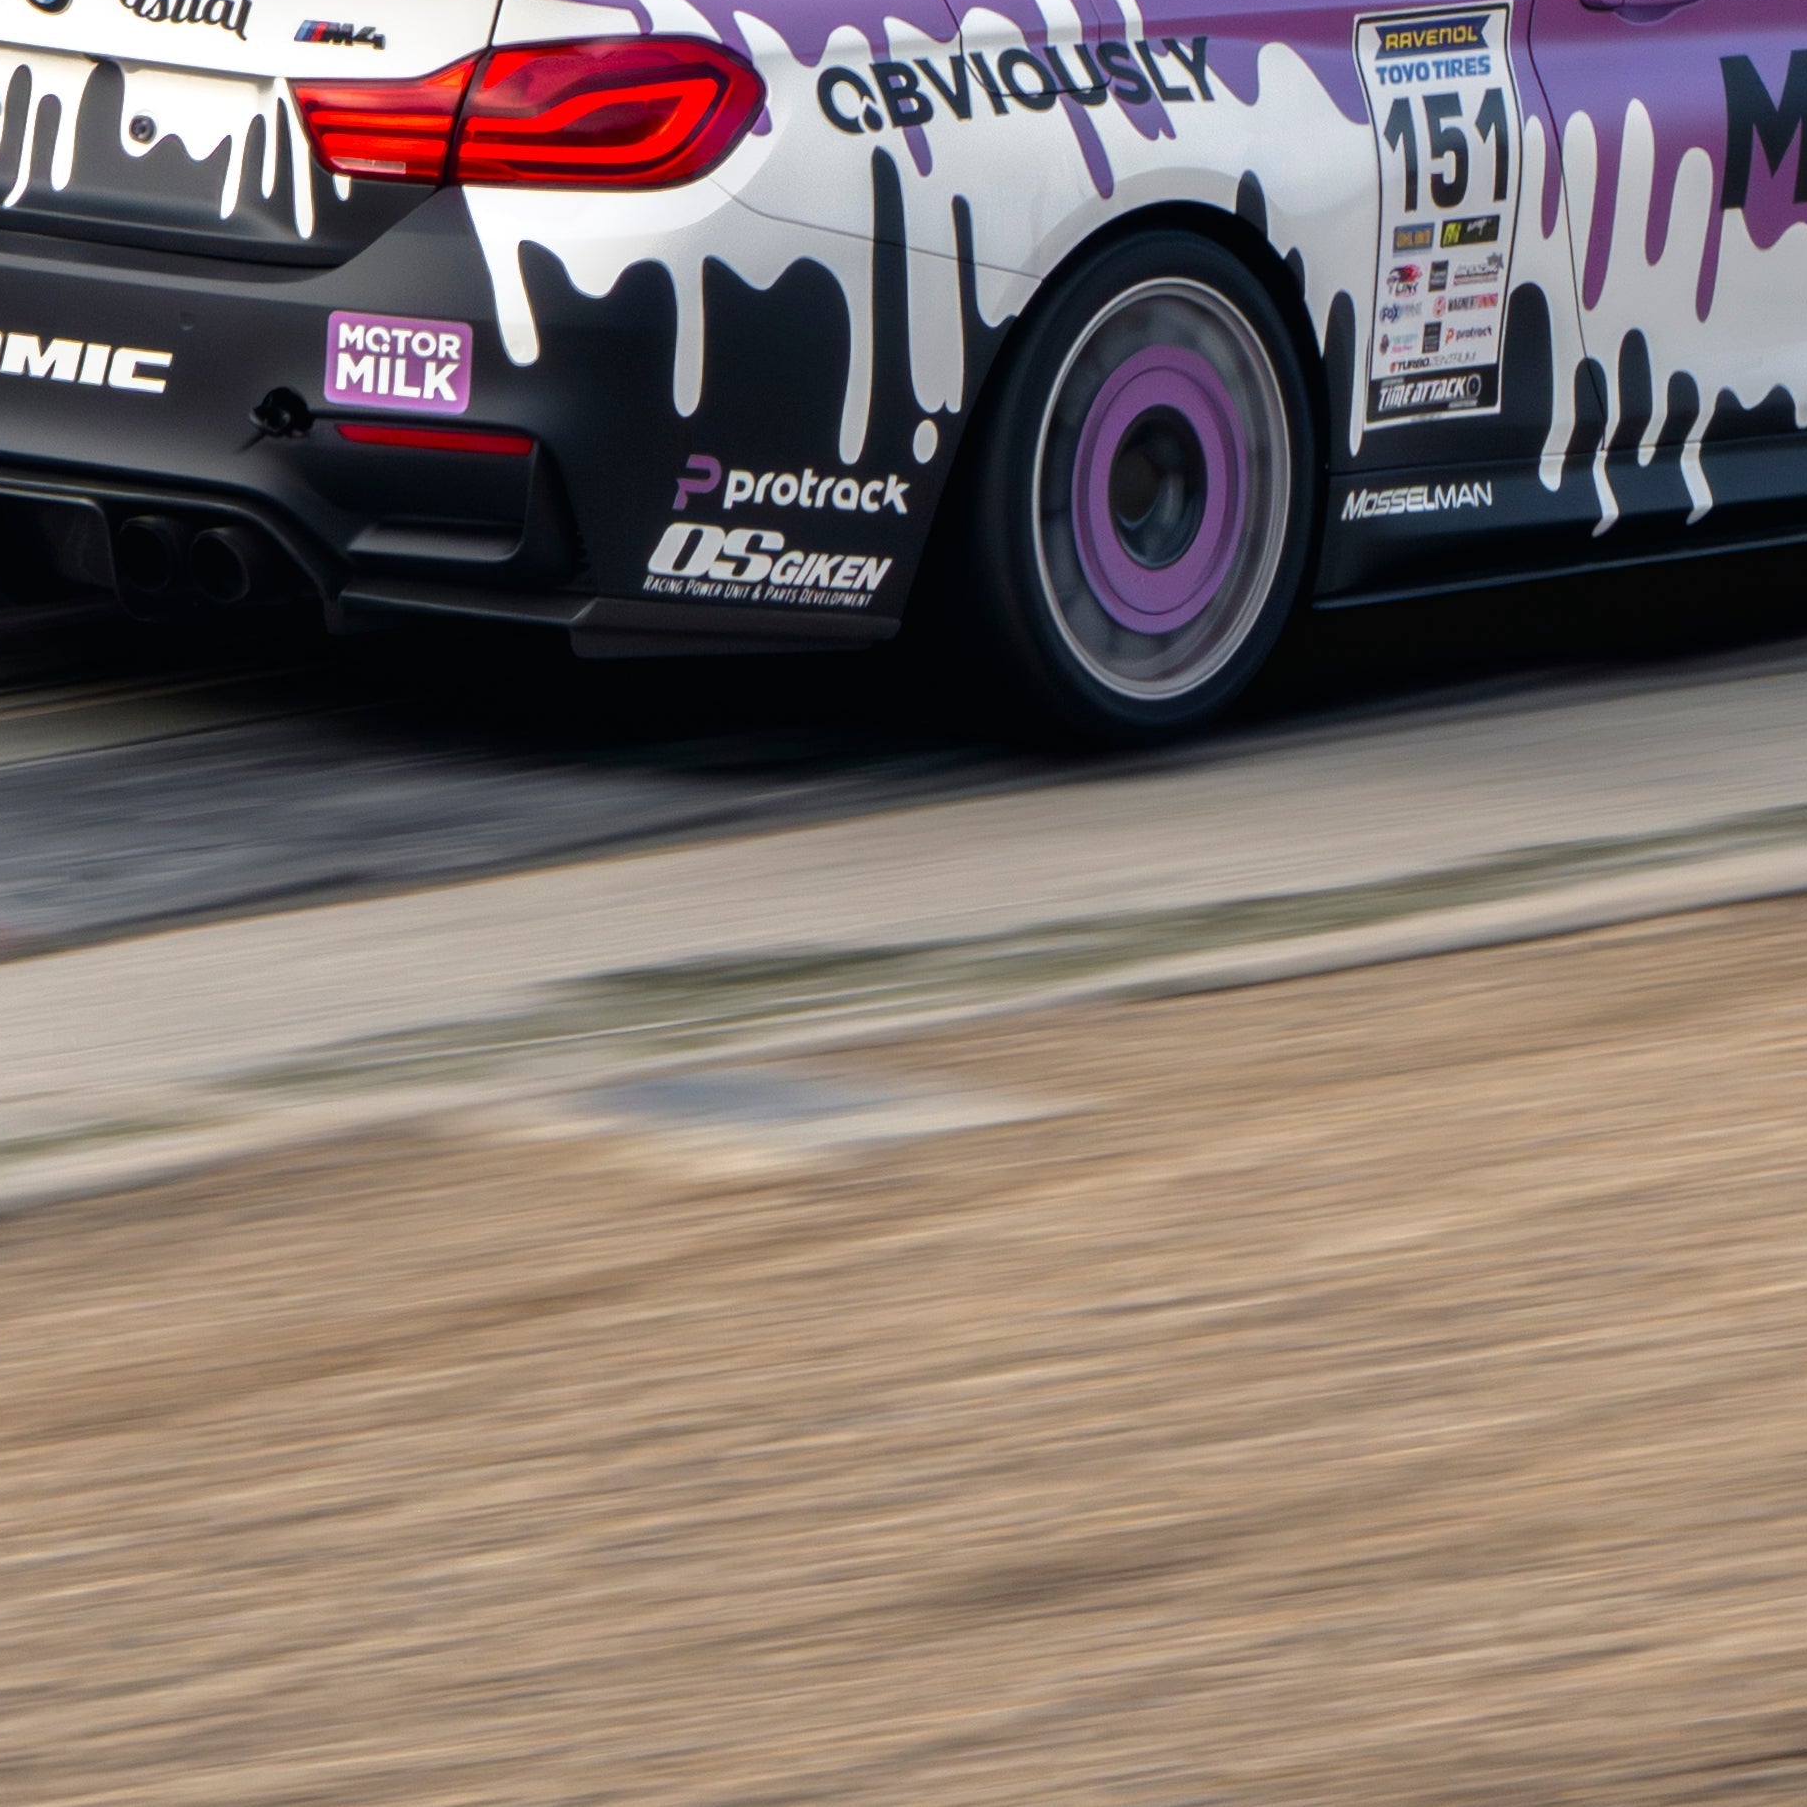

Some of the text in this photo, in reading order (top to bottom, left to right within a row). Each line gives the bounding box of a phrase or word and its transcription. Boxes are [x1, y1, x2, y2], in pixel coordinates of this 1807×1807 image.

[1385, 25, 1478, 51] RAVENOL
[817, 36, 1214, 134] OBVIOUSLY
[1376, 55, 1491, 86] TOYO TIRES
[1384, 87, 1509, 213] 151
[338, 322, 461, 360] MOTOR
[335, 351, 460, 402] MILK
[723, 468, 910, 514] protrack
[1342, 481, 1492, 521] MOSSELMAN
[769, 550, 892, 591] GIKEN
